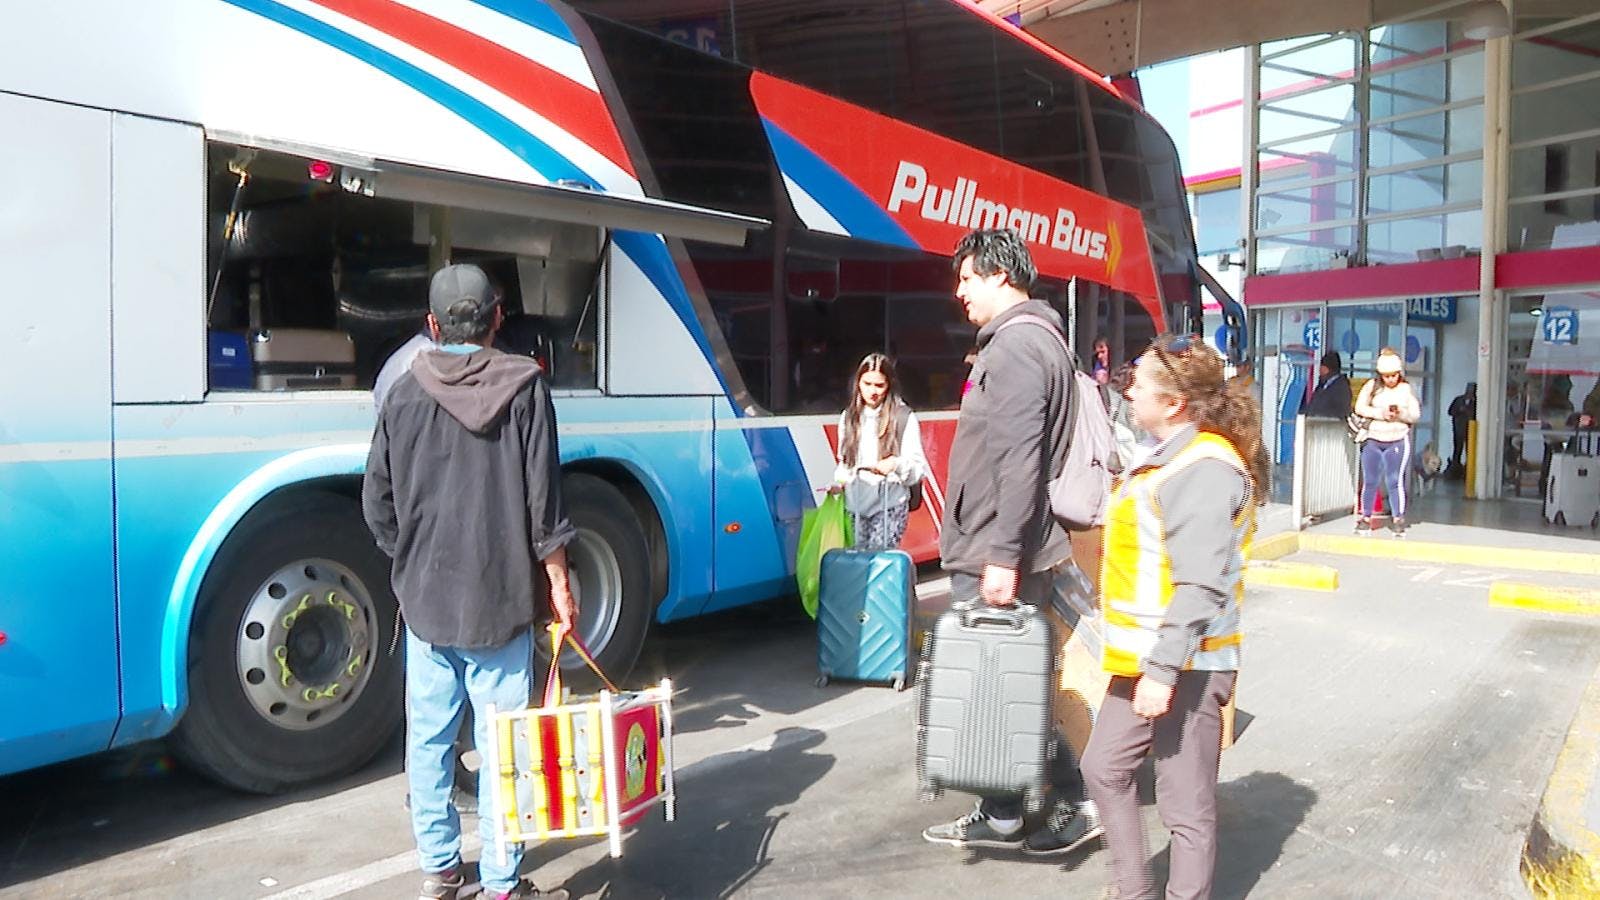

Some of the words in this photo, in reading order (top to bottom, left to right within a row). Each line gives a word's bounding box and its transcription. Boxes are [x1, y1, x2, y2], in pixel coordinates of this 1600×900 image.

[887, 160, 1051, 245] Pullman
[1357, 297, 1450, 317] IOALES
[1305, 327, 1321, 347] 13
[1546, 318, 1571, 341] 12
